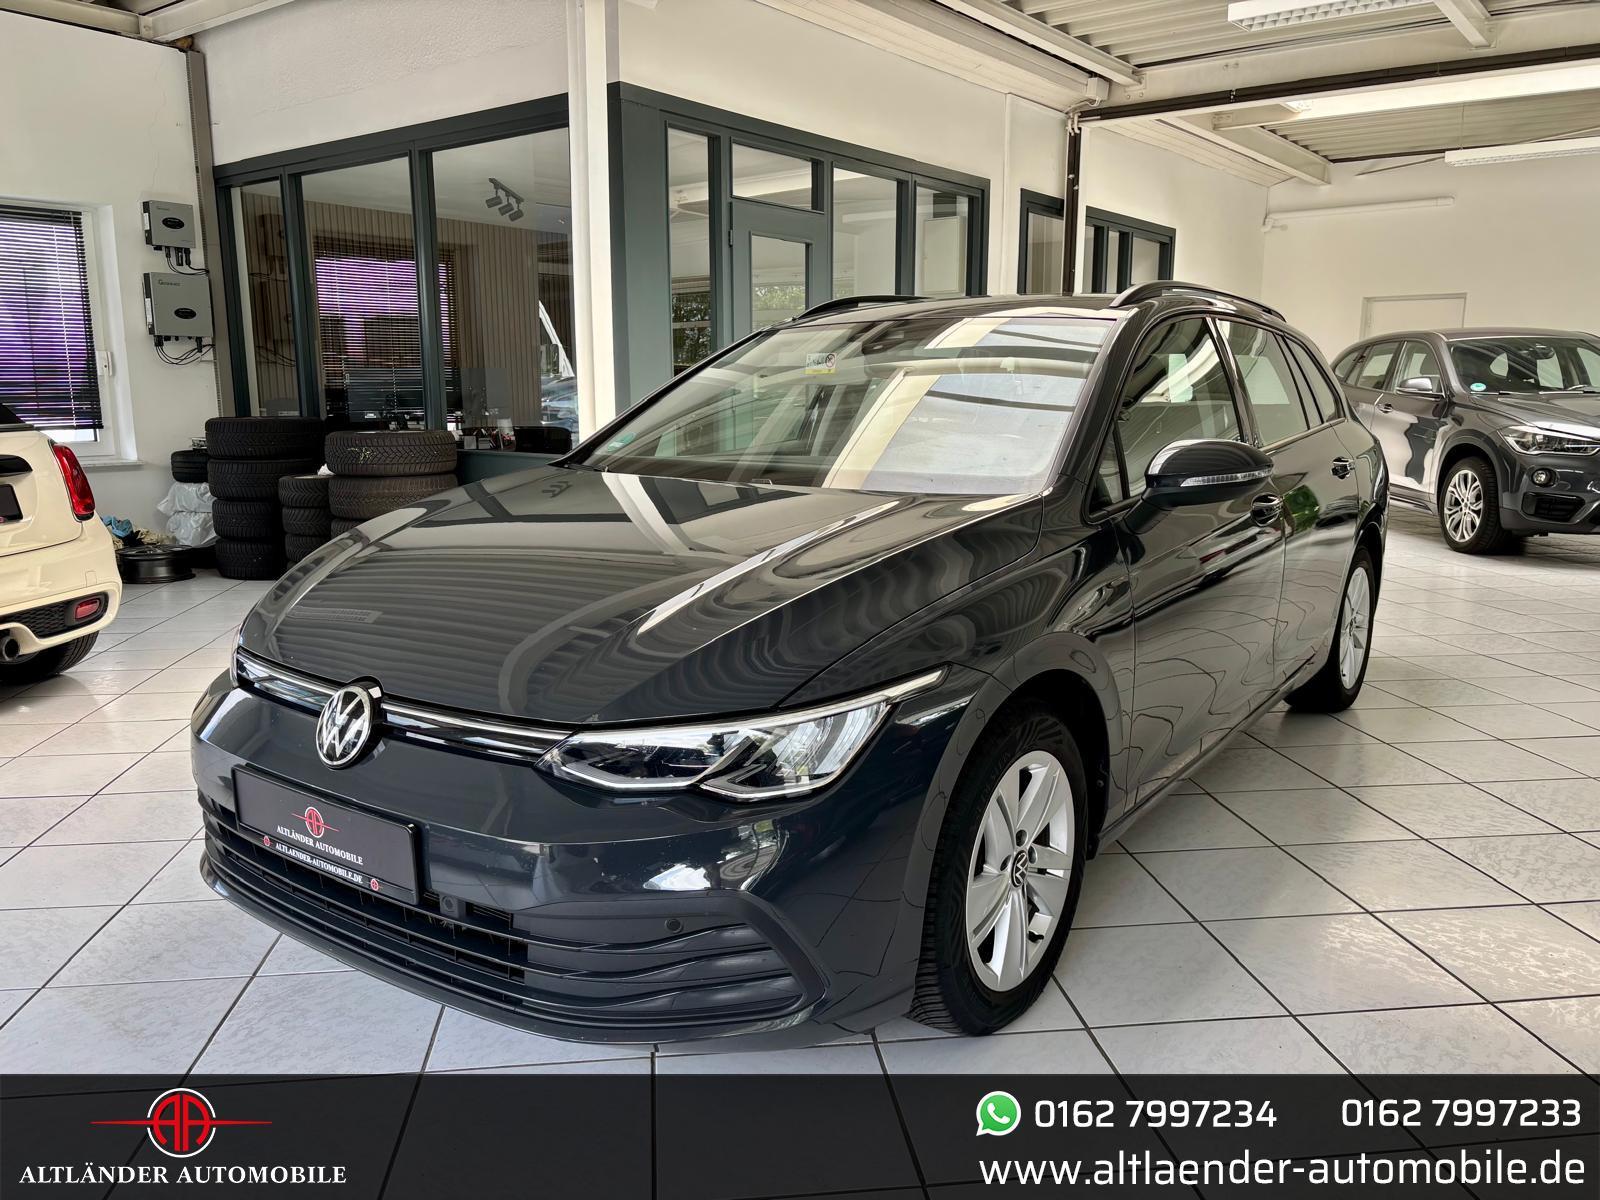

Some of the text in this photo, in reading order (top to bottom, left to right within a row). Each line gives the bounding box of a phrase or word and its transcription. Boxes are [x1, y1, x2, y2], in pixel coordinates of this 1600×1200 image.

[275, 842, 363, 884] ALTLAENDER-AUTOMOBILE.DE
[276, 825, 363, 865] ALTLÄNDER AUTOMOBILE
